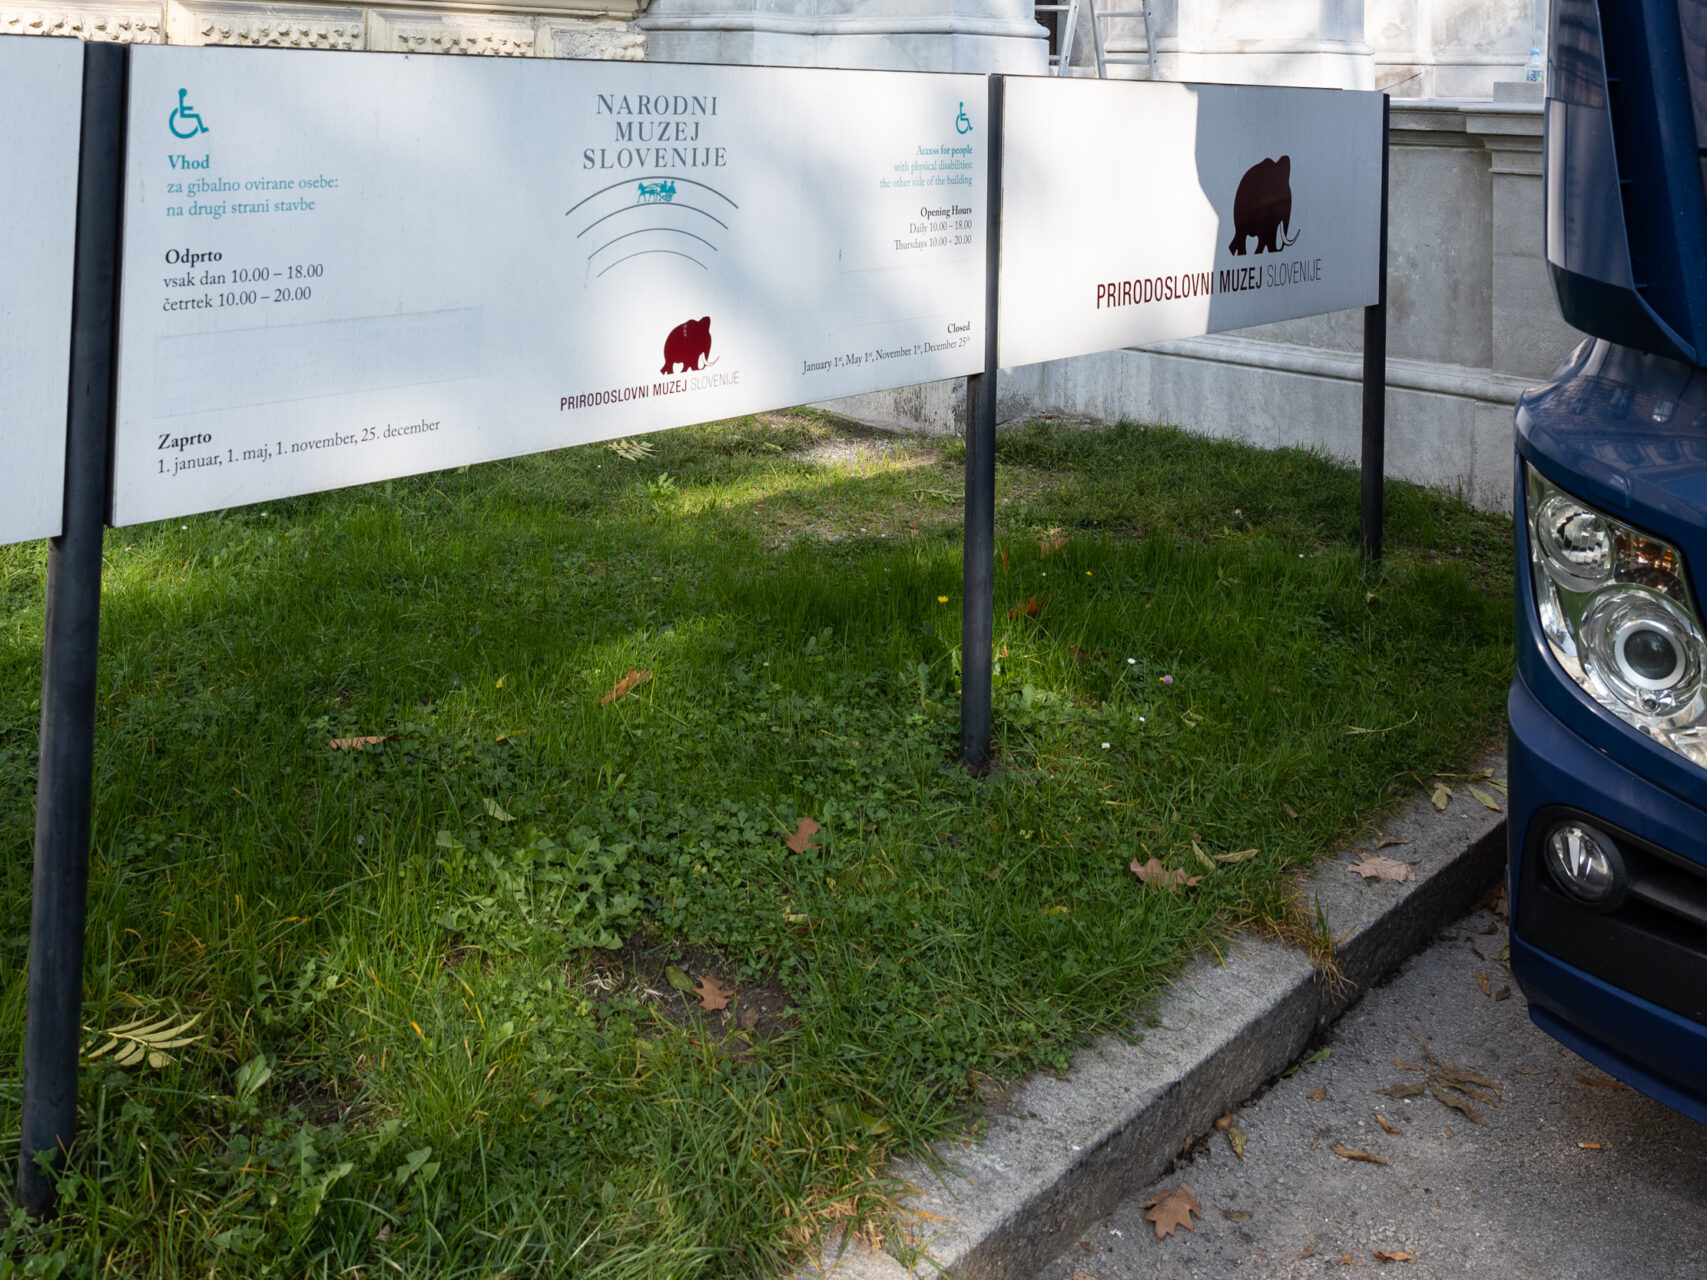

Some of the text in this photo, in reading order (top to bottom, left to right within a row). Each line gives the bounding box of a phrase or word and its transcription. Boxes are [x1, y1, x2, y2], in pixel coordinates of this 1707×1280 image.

[597, 94, 718, 116] NARODNI
[615, 122, 699, 142] MUZEJ
[583, 147, 727, 170] SLOVENIJE
[916, 144, 973, 157] Access for people
[168, 154, 210, 169] Vhod
[894, 159, 973, 175] with physical disabilities:
[167, 174, 339, 198] za gibalno ovirane osebe:
[880, 174, 972, 188] the other side of the building
[166, 198, 315, 220] na drugi strani stavbe
[921, 205, 972, 220] Opening Hours
[909, 223, 927, 236] Daily
[929, 222, 947, 232] 10.00
[955, 219, 972, 230] 18.00
[894, 238, 927, 251] Thursdays
[929, 237, 947, 247] 10.00
[954, 235, 972, 245] 20.00
[165, 249, 222, 268] Odprto
[163, 272, 196, 288] vsak
[200, 271, 225, 285] dan
[232, 267, 269, 283] 10.00
[287, 263, 323, 279] 18.00
[1096, 258, 1322, 310] PRIRODOSLOVNI MUZEJ SLOVENIJE
[163, 293, 213, 311] četrtek
[219, 290, 257, 307] 10.00
[274, 286, 311, 303] 20.00
[947, 321, 970, 334] Closed
[802, 360, 832, 375] January
[846, 353, 862, 367] May
[876, 349, 912, 361] November
[924, 340, 957, 353] December
[560, 371, 739, 411] PRIRODOSLOVNI MUZEJ SLOVENIJE
[158, 432, 212, 450] Zaprto
[158, 419, 440, 476] 1. januar, 1. maj, 1. november, 25. december
